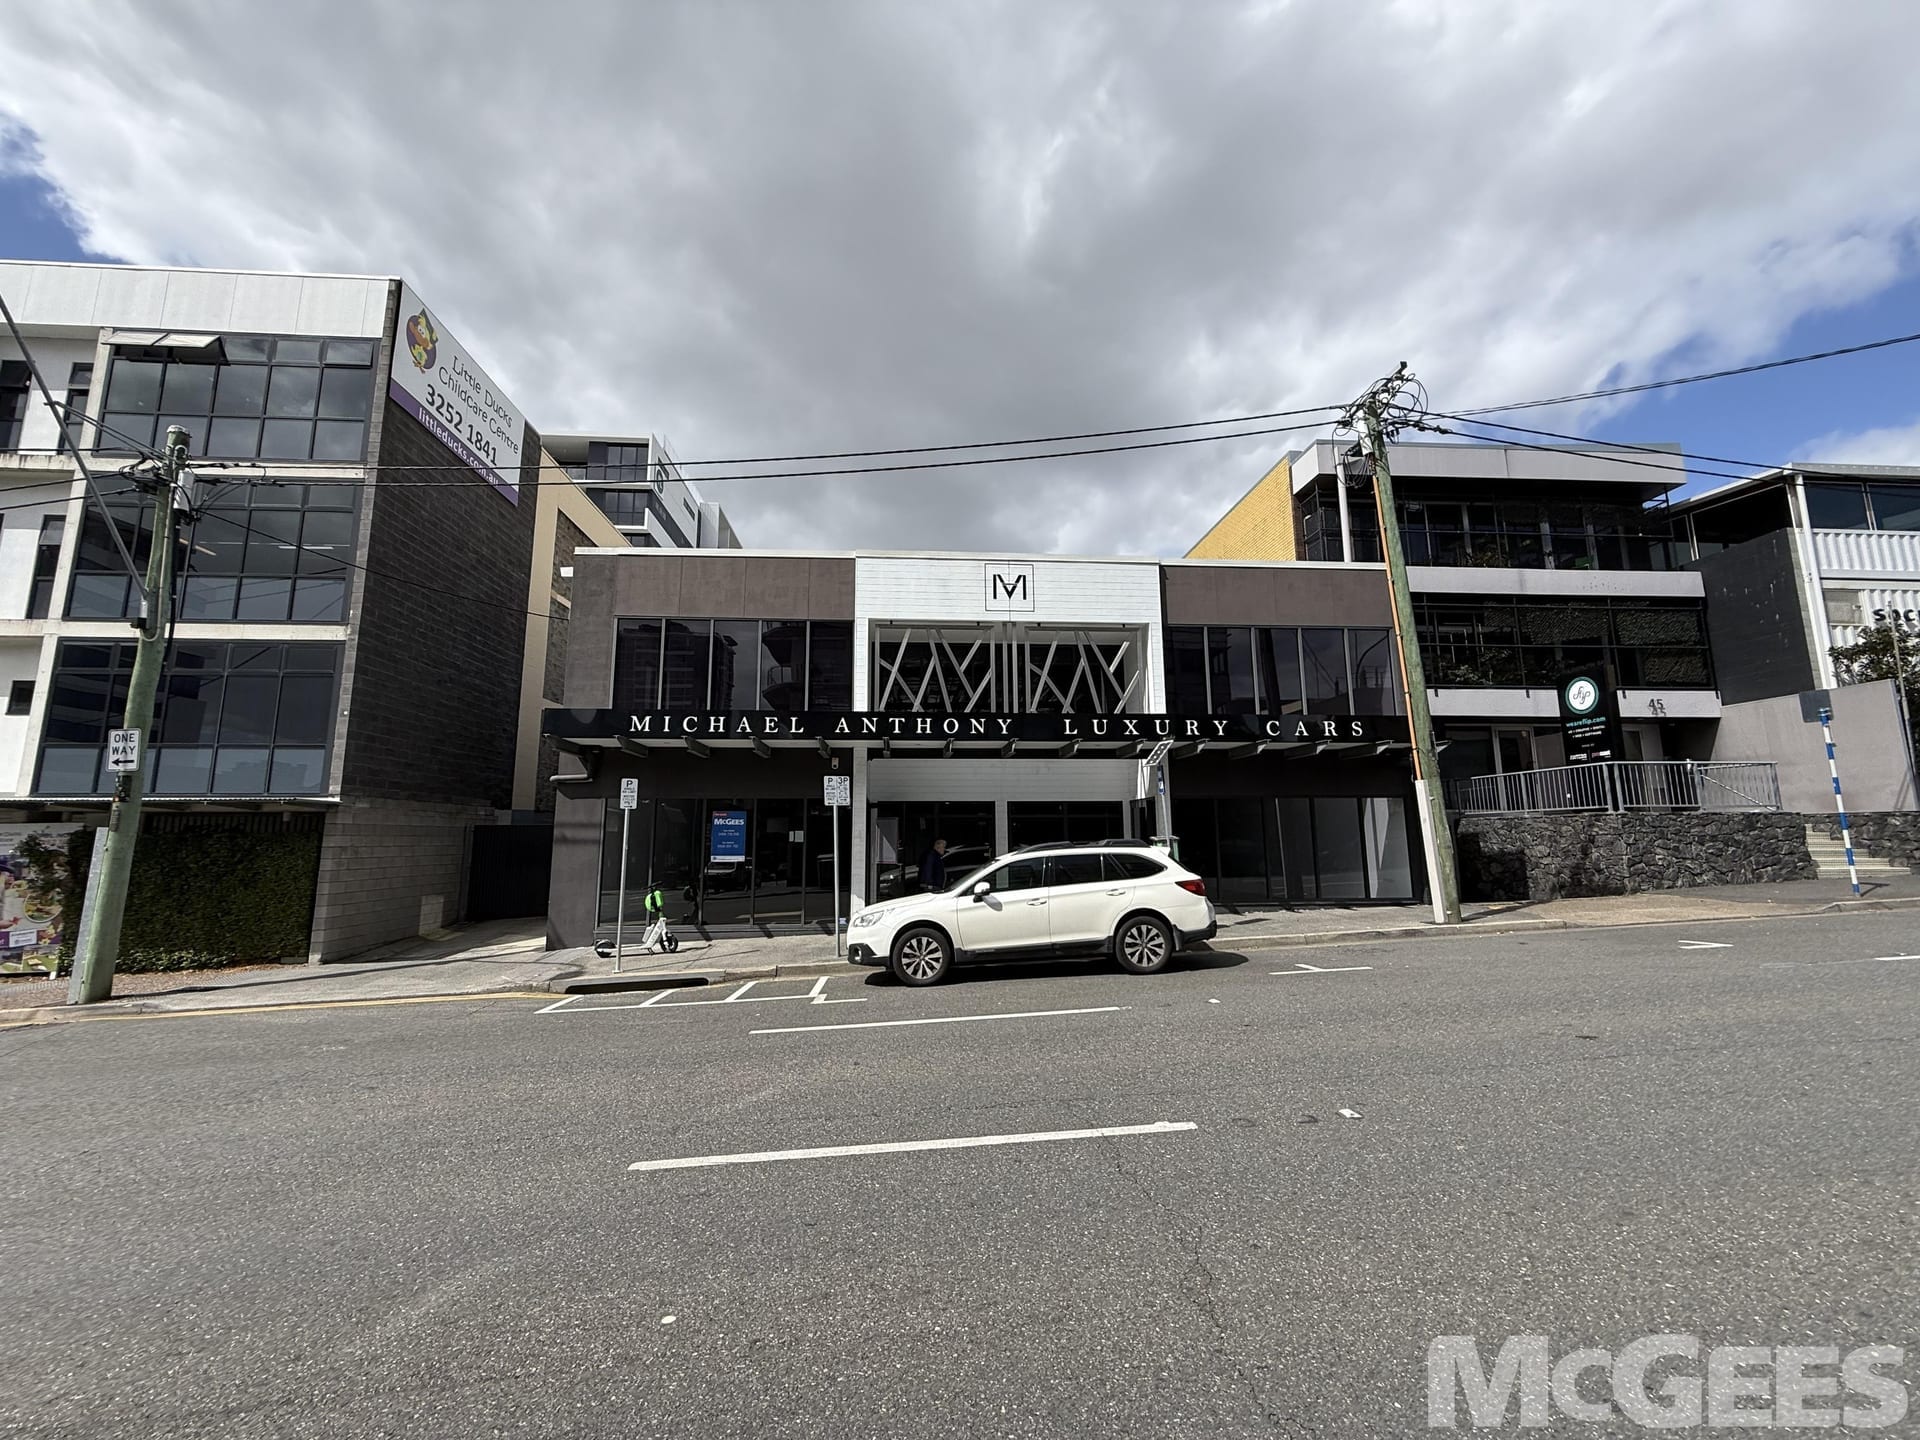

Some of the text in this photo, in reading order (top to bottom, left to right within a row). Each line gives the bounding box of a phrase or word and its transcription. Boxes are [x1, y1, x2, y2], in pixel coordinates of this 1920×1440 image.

[452, 355, 513, 428] Little Ducks
[438, 366, 519, 455] Childcare Centre
[425, 384, 498, 466] 3252 1841
[1872, 608, 1920, 622] soc
[1648, 698, 1664, 712] 45
[629, 715, 1363, 737] MICHAEL ANTHONY LUXURY CARS
[114, 733, 135, 743] ONE
[112, 745, 136, 755] WAY
[626, 780, 634, 788] P
[827, 777, 834, 785] P
